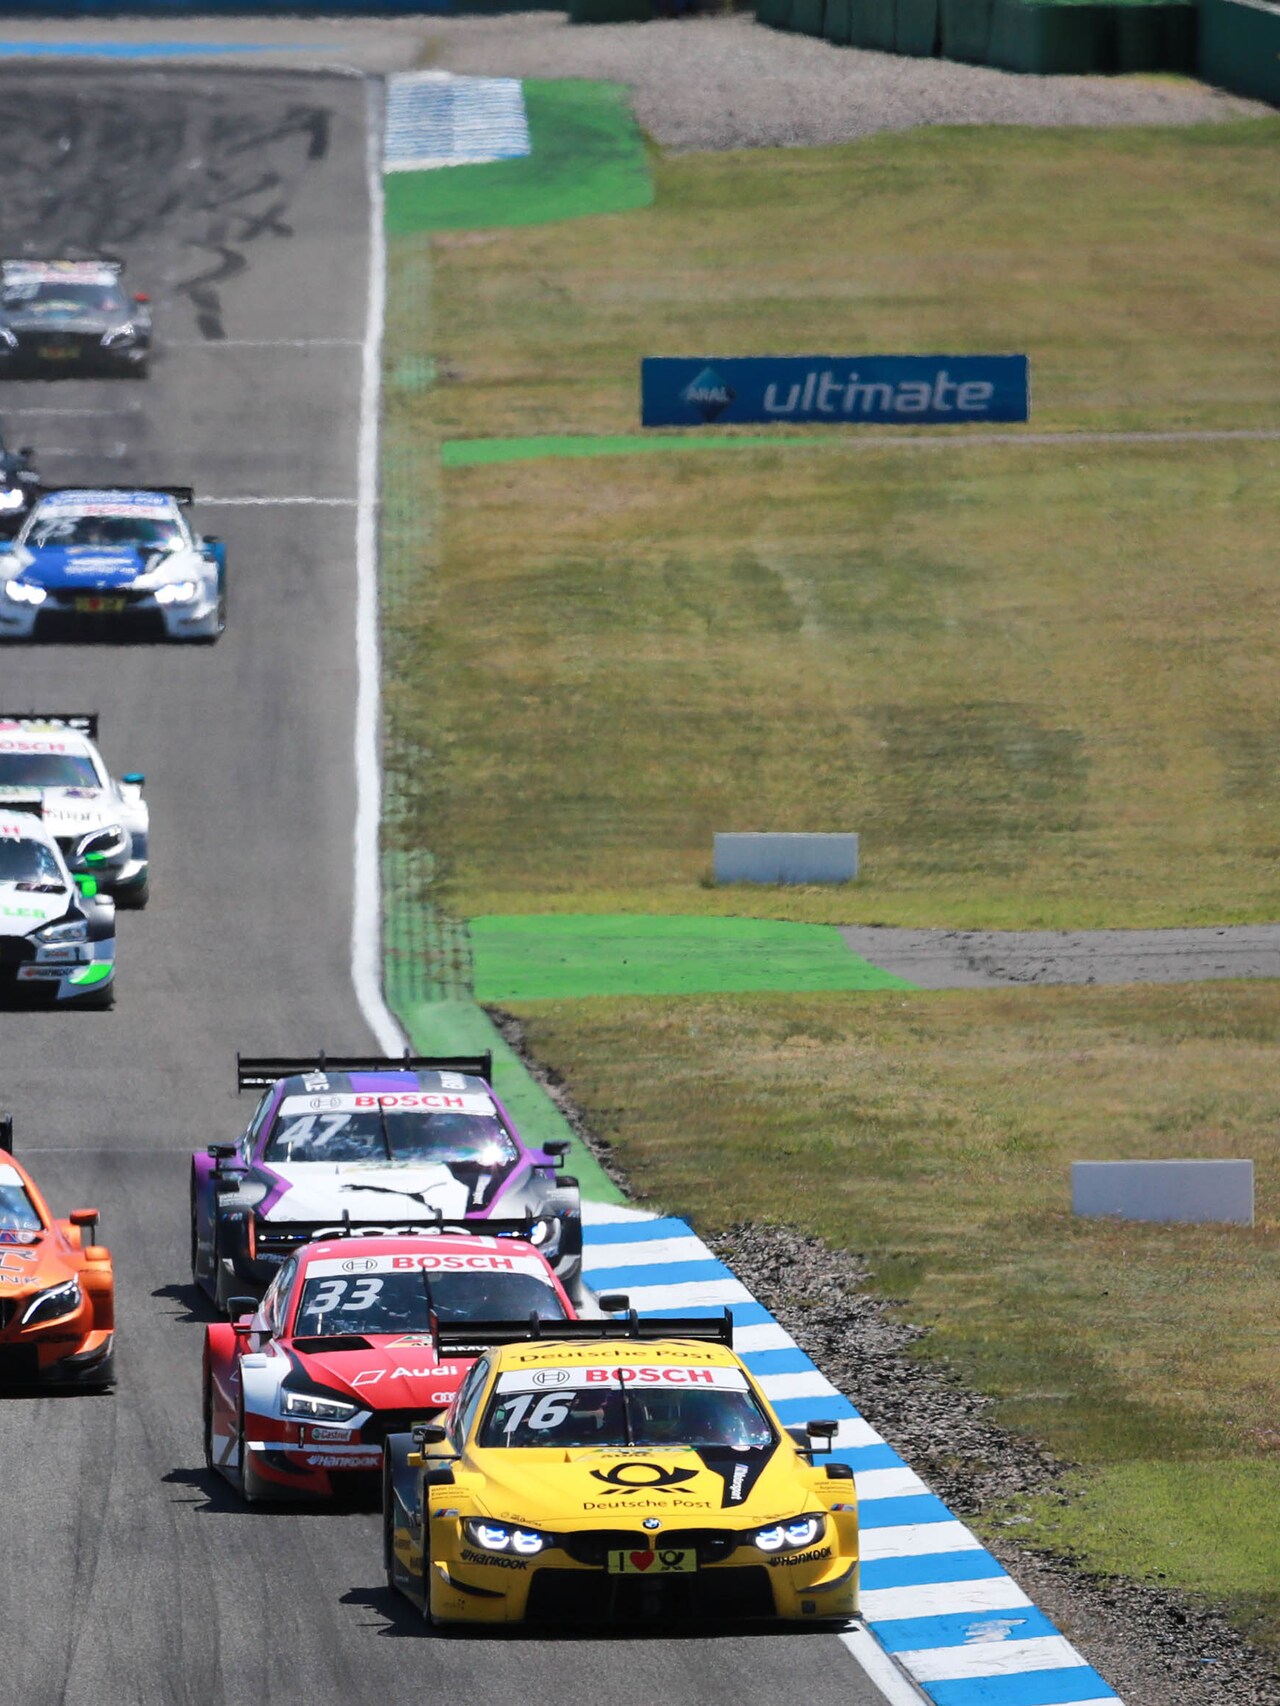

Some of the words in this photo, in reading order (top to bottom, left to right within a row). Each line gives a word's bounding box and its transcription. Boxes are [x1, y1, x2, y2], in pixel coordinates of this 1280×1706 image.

[763, 370, 994, 412] ultimate
[354, 1095, 464, 1107] BOSCH
[276, 1114, 352, 1146] 47
[392, 1256, 513, 1270] BOSCH
[306, 1278, 384, 1314] 33
[520, 1349, 647, 1363] Deutsche
[656, 1350, 715, 1361] Post
[390, 1366, 459, 1379] Audi
[586, 1367, 714, 1383] BOSCH
[502, 1391, 577, 1433] 16
[583, 1499, 668, 1510] Deutsche
[670, 1499, 713, 1509] Post
